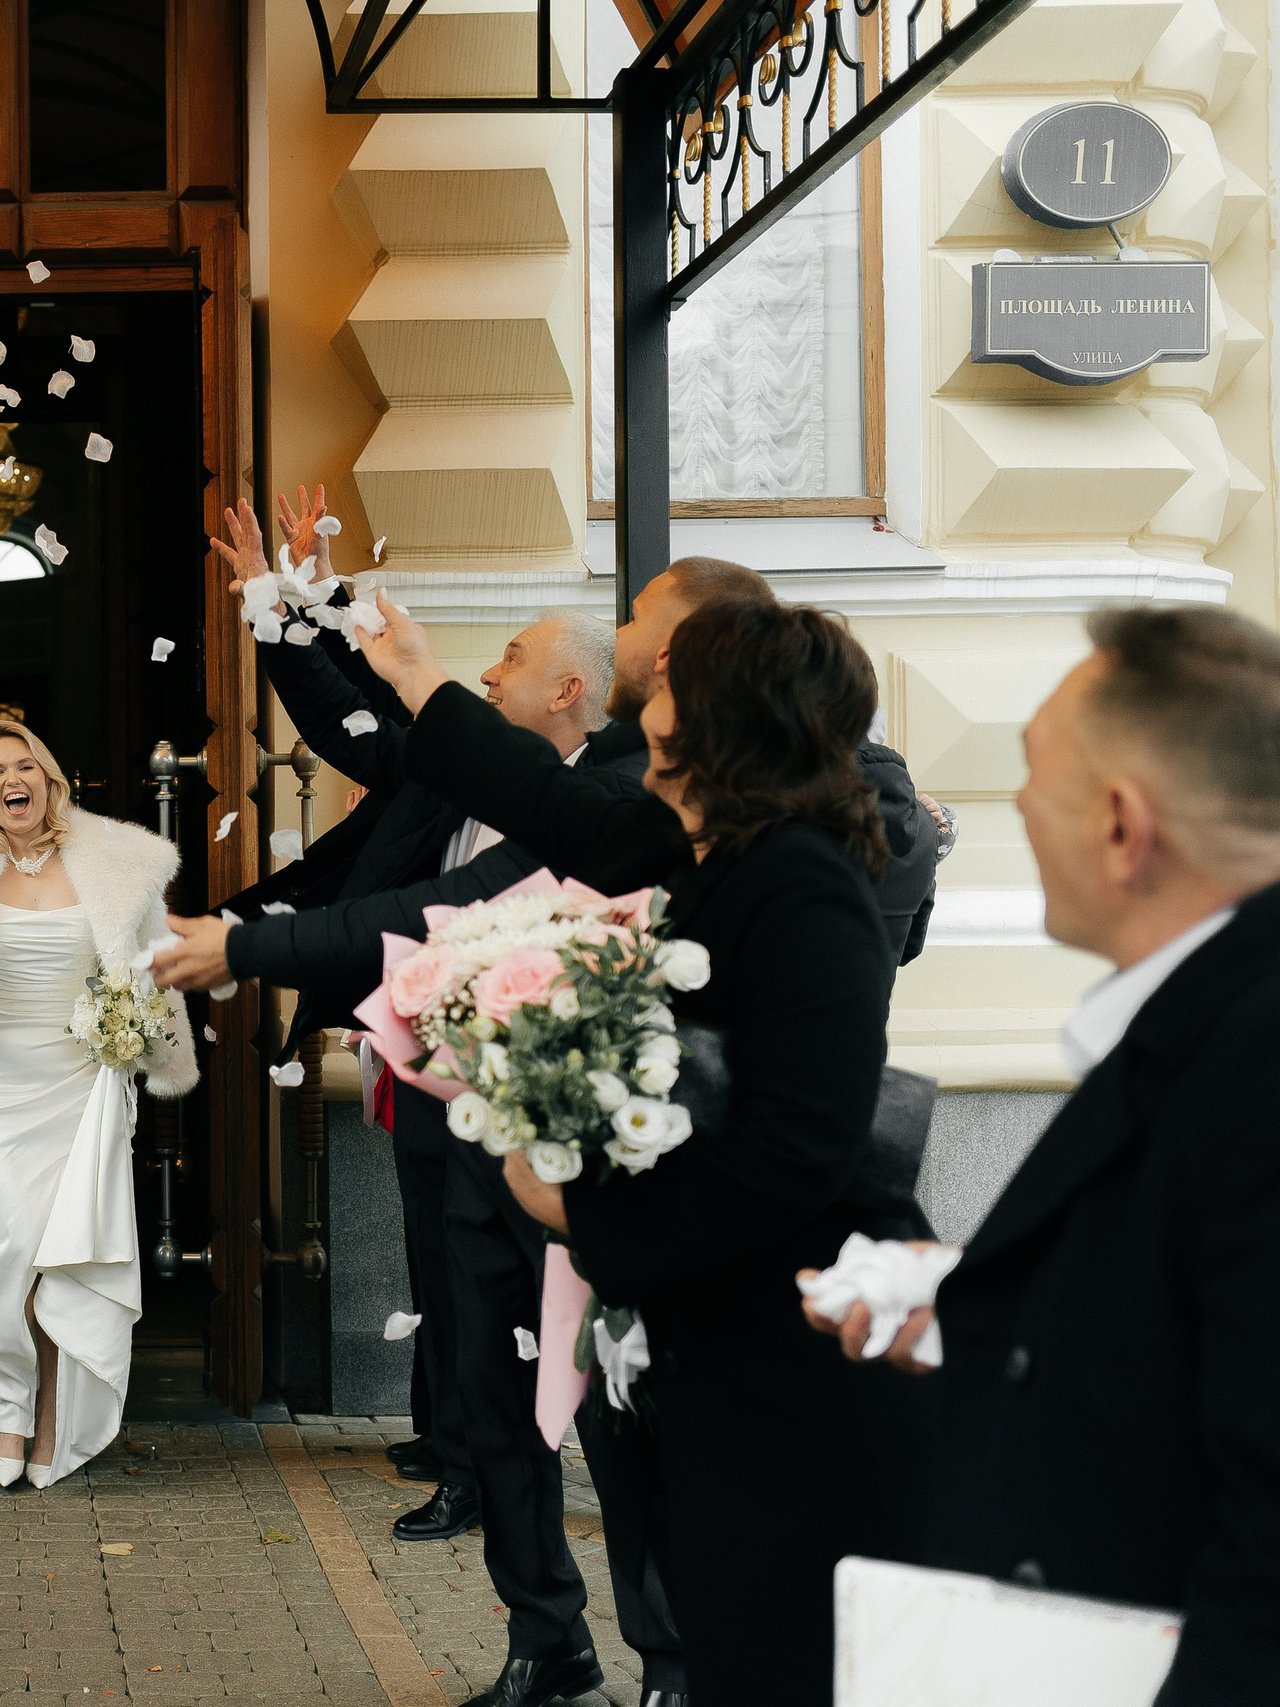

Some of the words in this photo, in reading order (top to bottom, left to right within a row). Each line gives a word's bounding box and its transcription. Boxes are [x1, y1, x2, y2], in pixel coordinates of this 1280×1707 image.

[1070, 138, 1116, 185] 11
[999, 299, 1102, 317] ПЛОЩАДЬ
[1110, 299, 1196, 315] ЛЕНИНА
[1072, 351, 1123, 364] УЛИЦА
